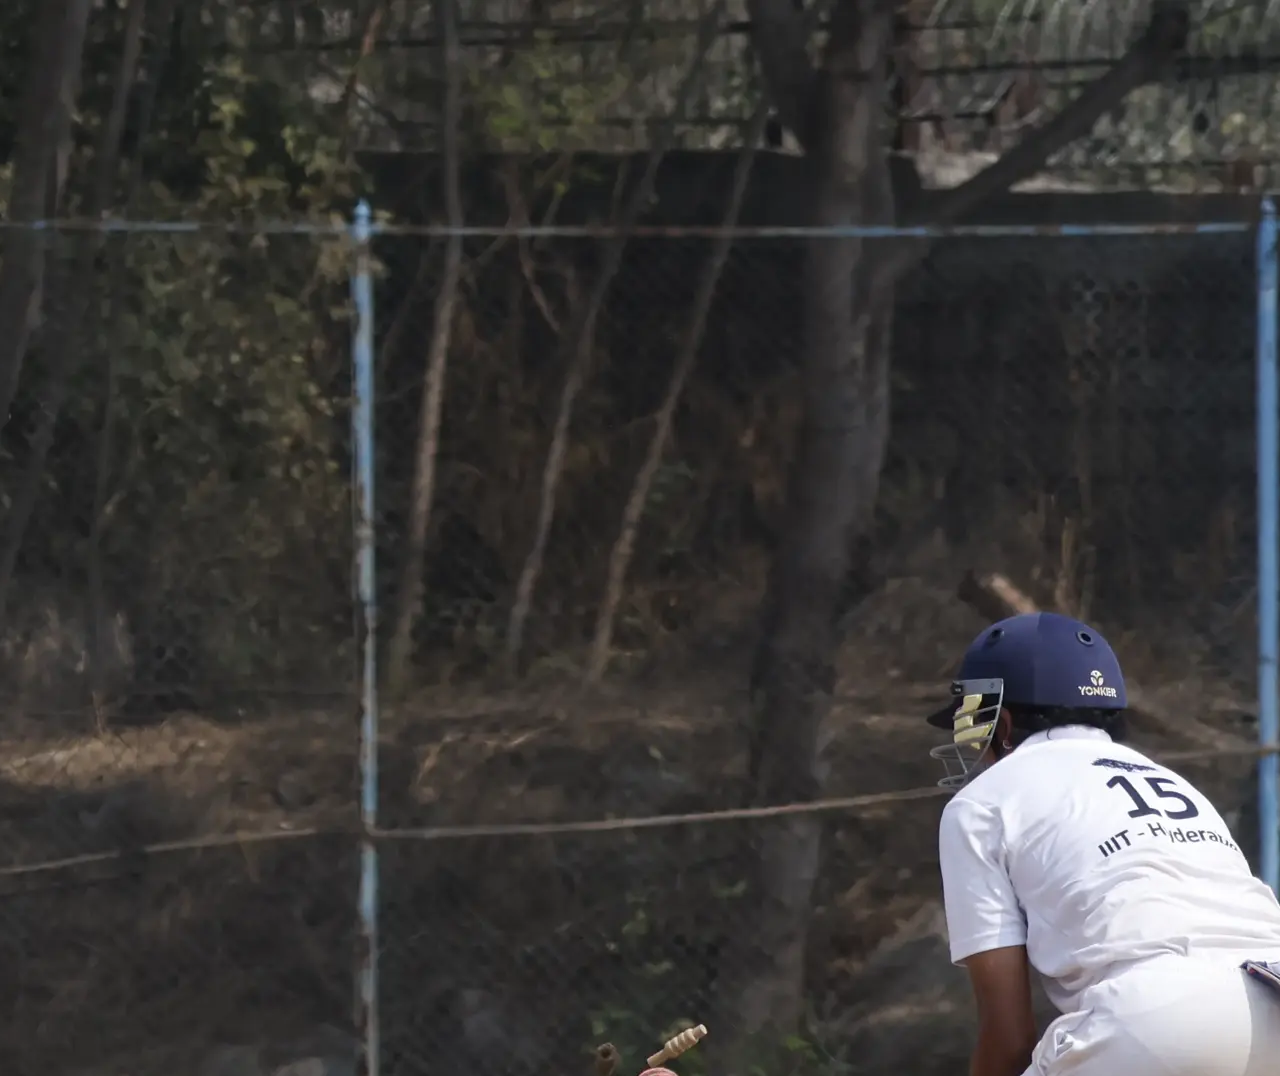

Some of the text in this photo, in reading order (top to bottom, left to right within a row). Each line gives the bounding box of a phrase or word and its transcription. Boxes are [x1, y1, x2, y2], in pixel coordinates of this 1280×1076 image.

[1078, 686, 1117, 698] YONKER
[1106, 775, 1199, 820] 15
[1098, 829, 1131, 857] IIIT
